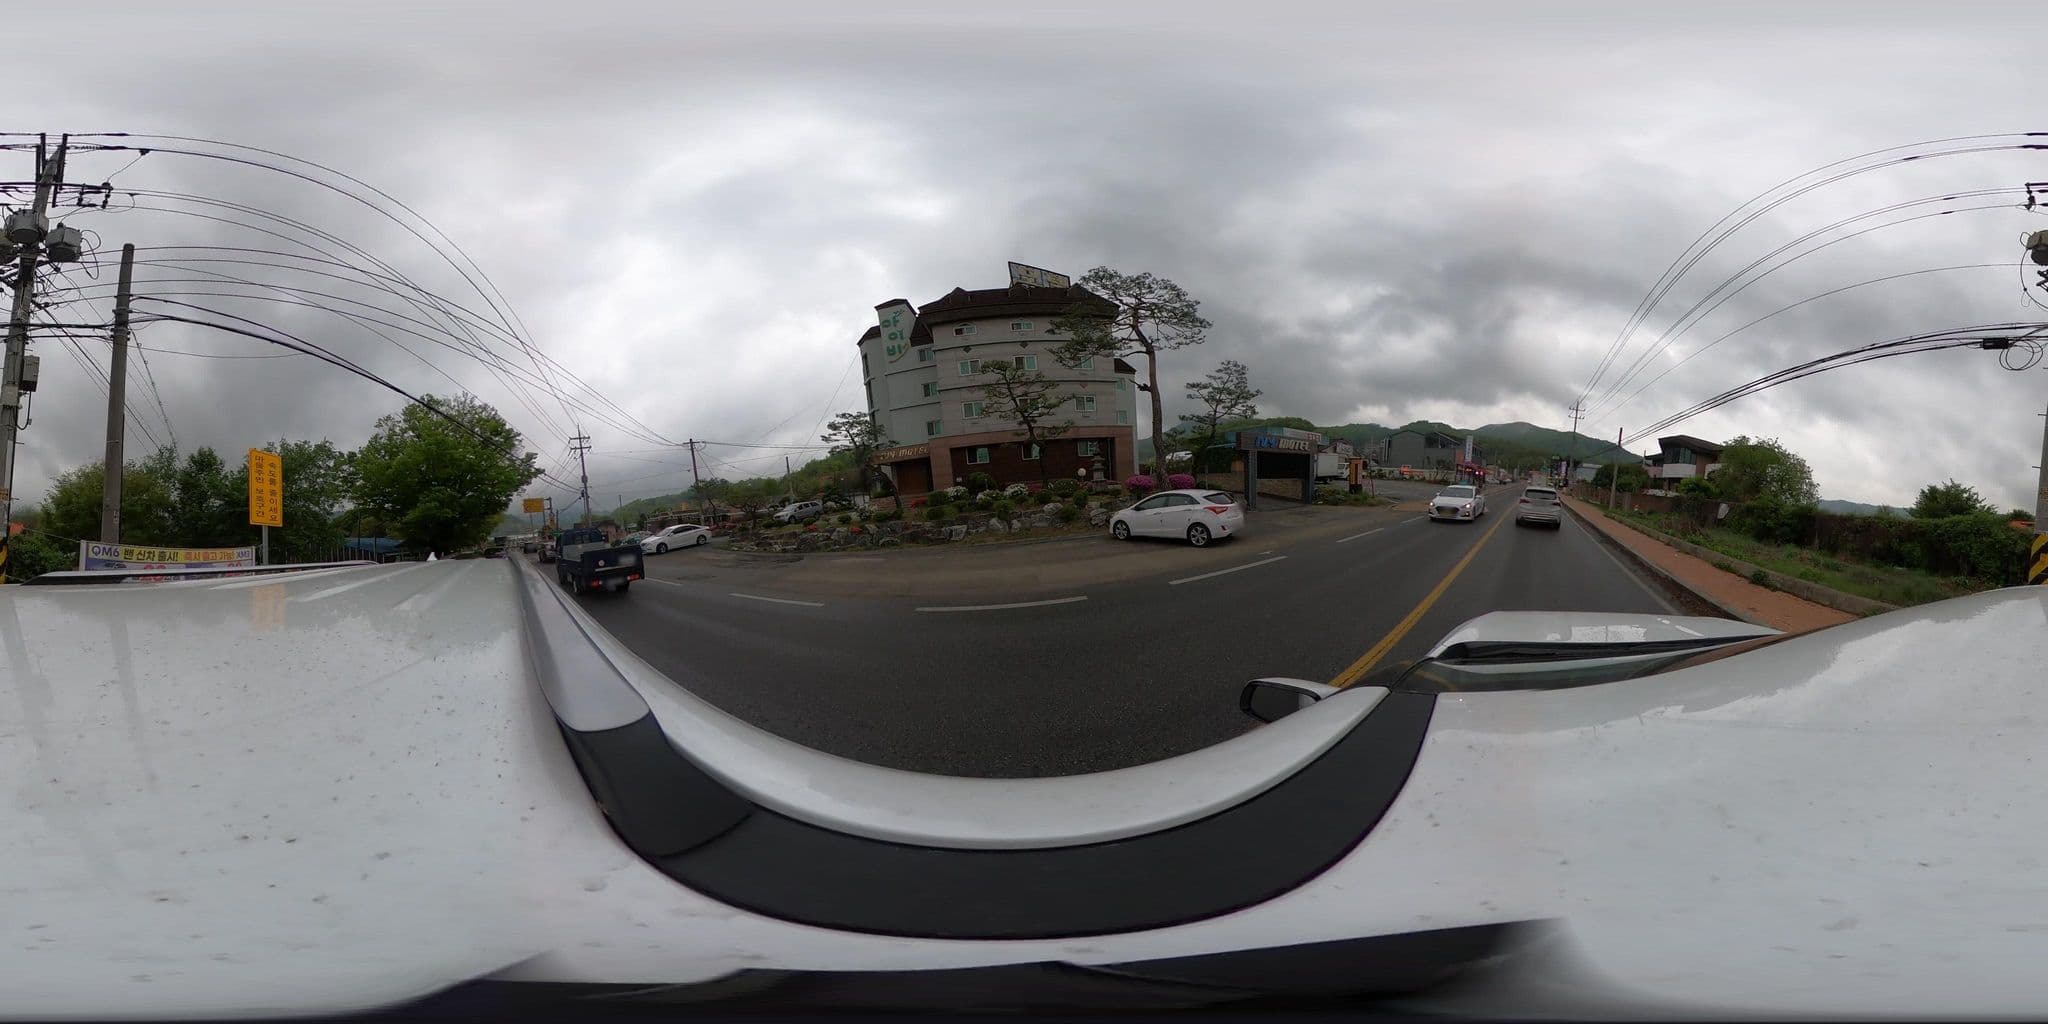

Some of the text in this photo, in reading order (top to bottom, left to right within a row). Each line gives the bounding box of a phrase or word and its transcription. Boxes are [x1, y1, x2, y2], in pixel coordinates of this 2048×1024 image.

[1279, 438, 1310, 451] MOTEL
[255, 455, 265, 517] 마을주민 보호구간
[268, 462, 279, 521] 속도를 줄이세요
[91, 545, 120, 557] QM6
[136, 550, 155, 561] 신차
[158, 551, 179, 562] 출시!
